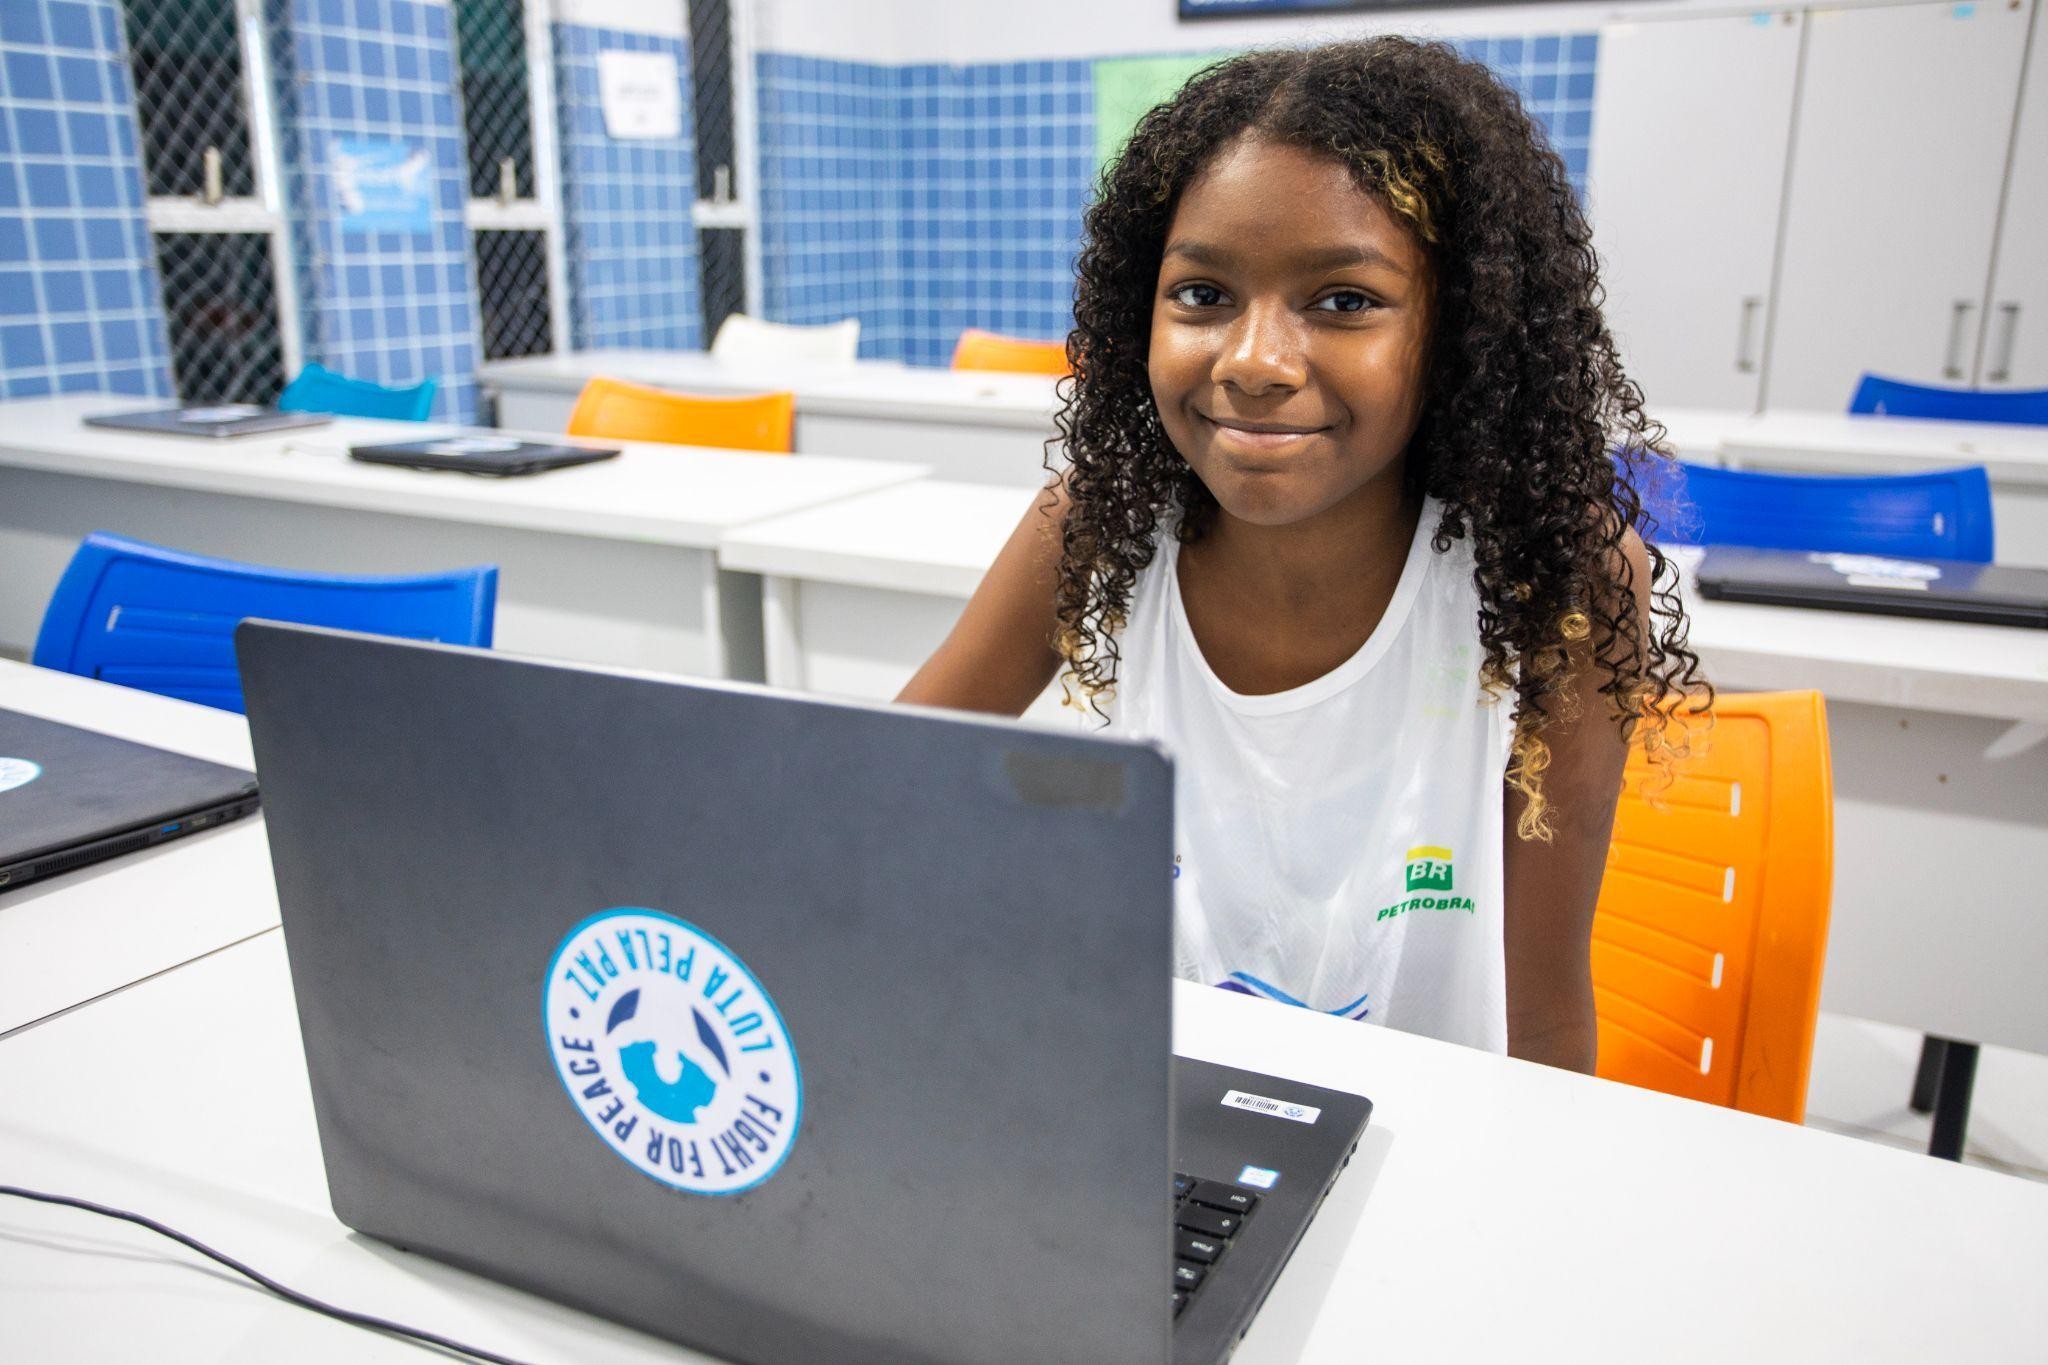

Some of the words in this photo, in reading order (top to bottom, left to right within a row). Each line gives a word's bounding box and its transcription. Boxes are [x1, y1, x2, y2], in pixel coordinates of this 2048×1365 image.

[1409, 860, 1448, 881] BR
[564, 938, 619, 1003] PAZ
[616, 928, 696, 983] PELA
[704, 965, 774, 1052] LUTA
[561, 1034, 639, 1143] PEACE
[646, 1127, 705, 1177] FOR
[710, 1093, 783, 1176] FIGHT
